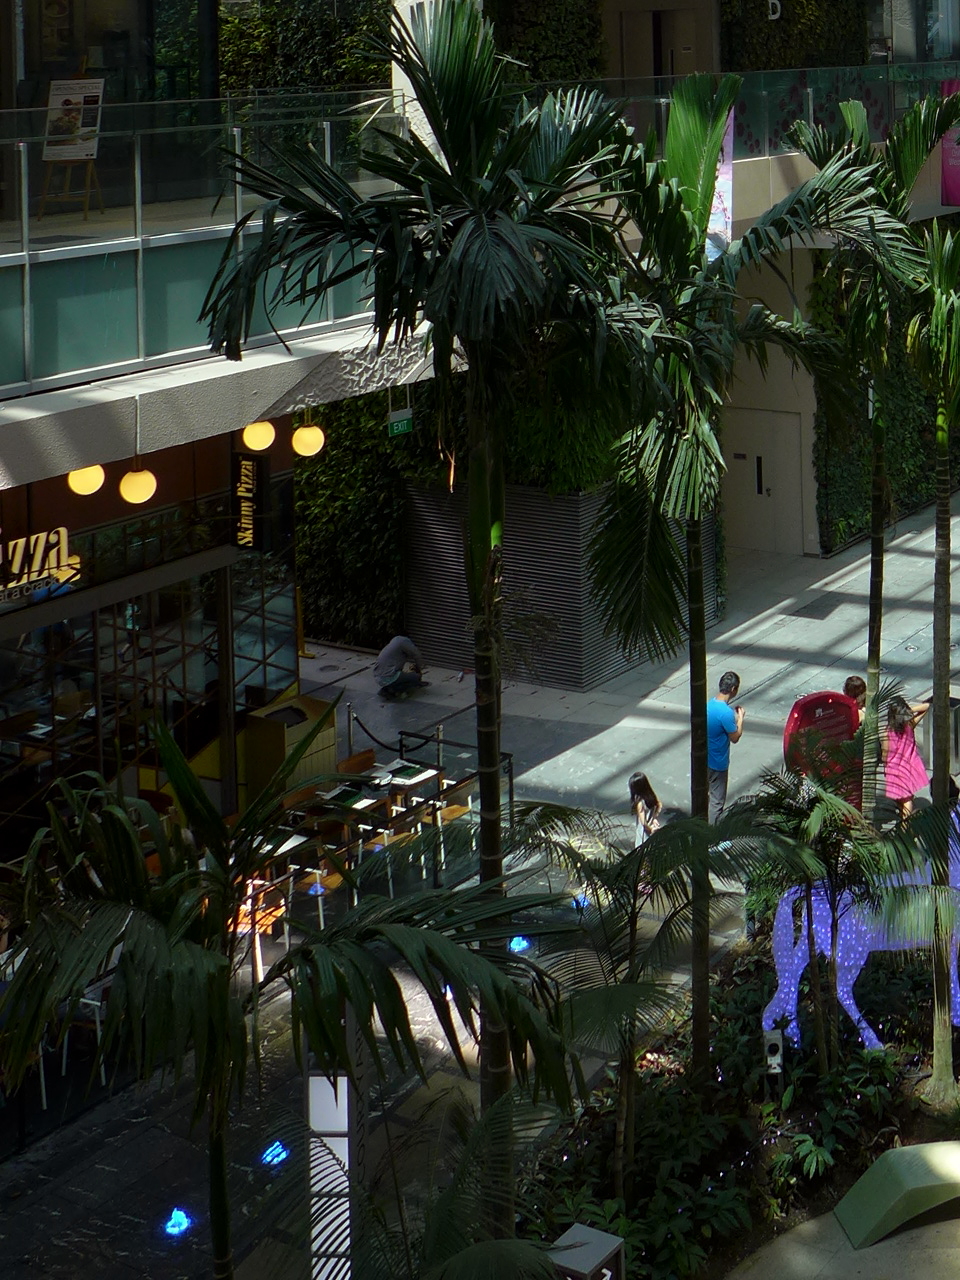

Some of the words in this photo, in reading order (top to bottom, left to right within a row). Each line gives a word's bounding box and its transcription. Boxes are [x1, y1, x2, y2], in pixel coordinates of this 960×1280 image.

[393, 421, 408, 433] EXIT
[236, 460, 253, 497] Pizza
[236, 500, 256, 548] Skinny
